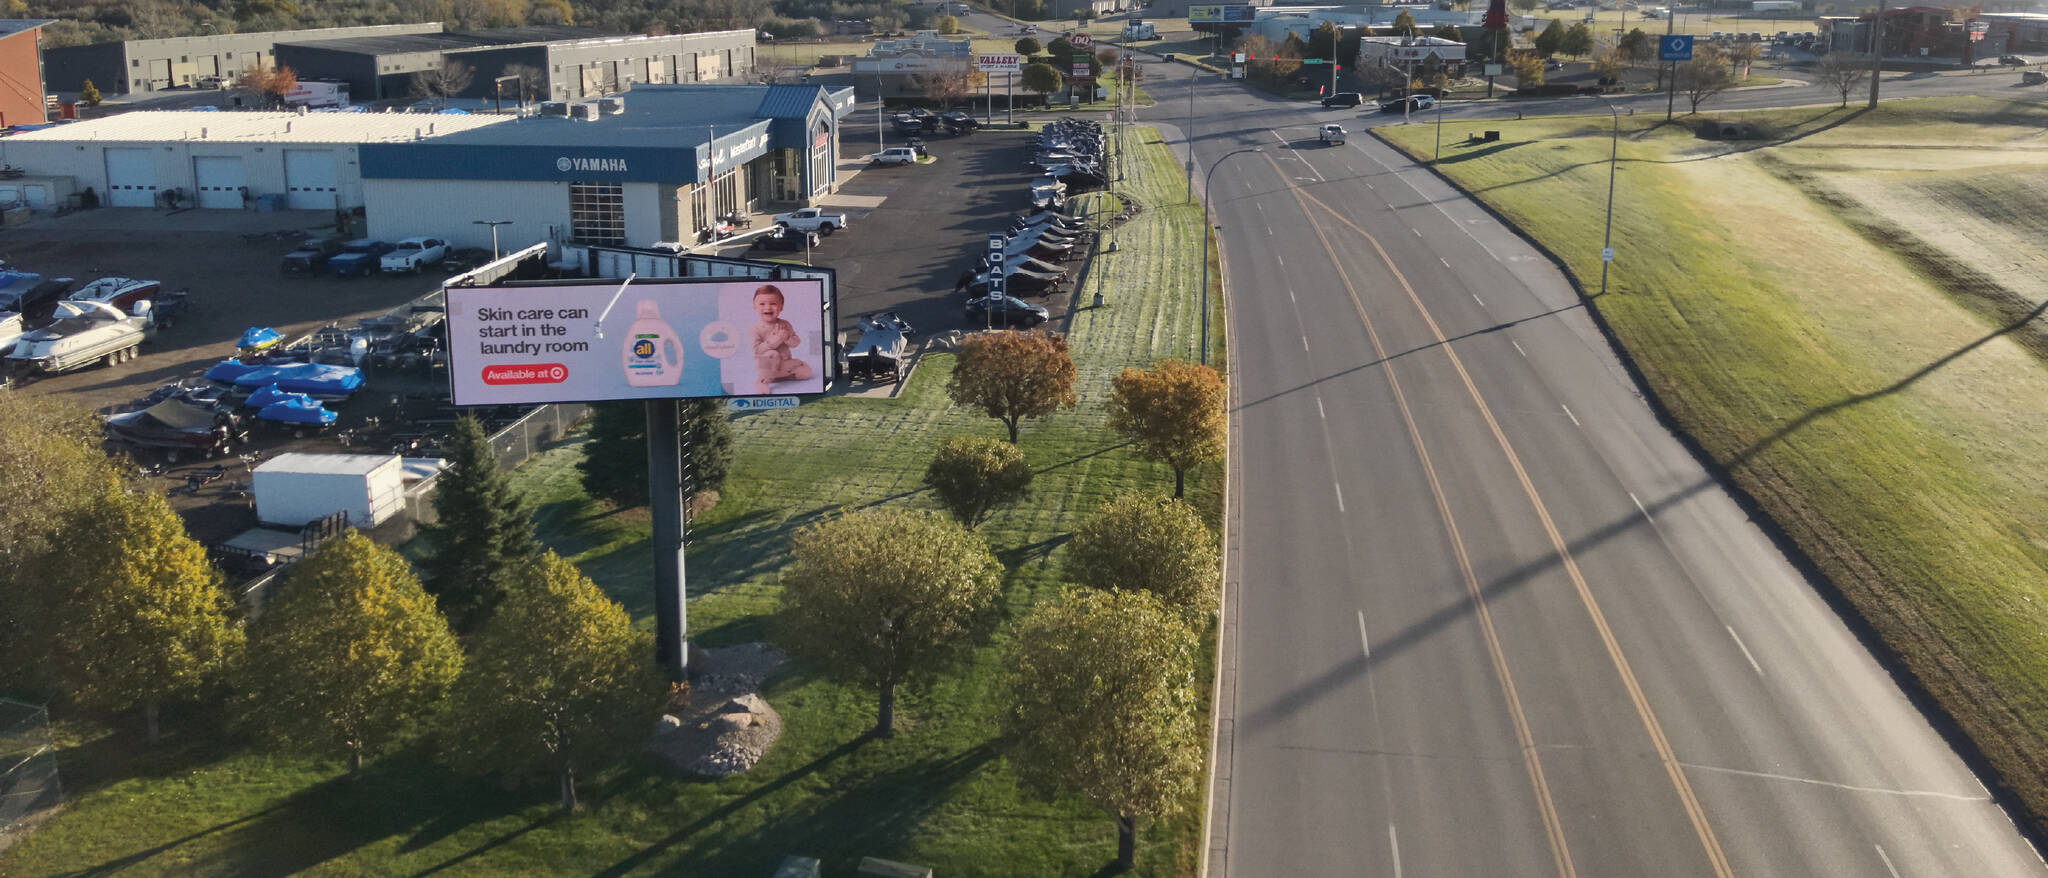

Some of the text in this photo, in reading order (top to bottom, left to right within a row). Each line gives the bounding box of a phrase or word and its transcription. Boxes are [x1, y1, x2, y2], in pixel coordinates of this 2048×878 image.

[1075, 36, 1090, 44] DQ
[980, 56, 1018, 64] VALLELY
[573, 158, 628, 171] YAMAHA
[990, 240, 1002, 300] BOATS
[478, 307, 588, 321] Skin care can
[479, 323, 567, 338] start in the
[480, 341, 589, 356] laundry room
[635, 343, 651, 355] all
[487, 369, 549, 380] Available at
